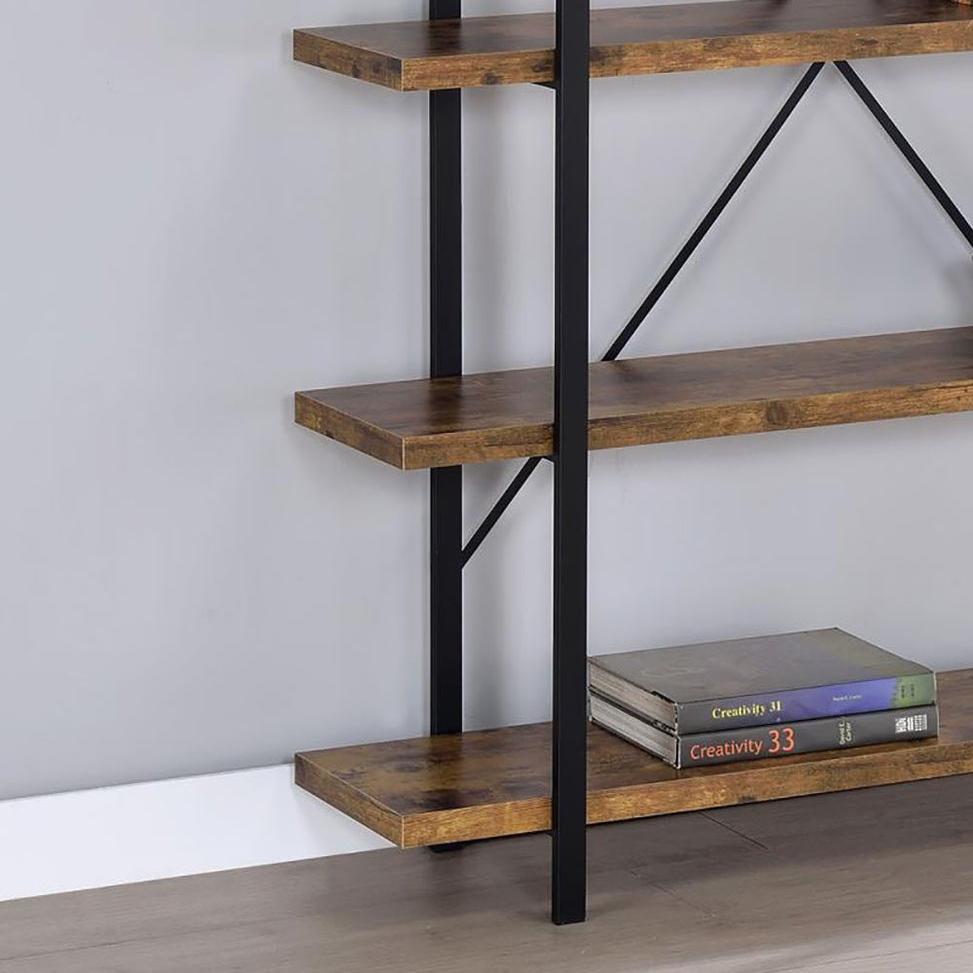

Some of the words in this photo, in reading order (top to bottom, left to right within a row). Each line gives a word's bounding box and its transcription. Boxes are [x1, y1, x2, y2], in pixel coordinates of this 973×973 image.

[711, 704, 765, 719] Creativity
[769, 701, 781, 712] 31
[690, 738, 763, 760] Creativity
[768, 727, 795, 753] 33
